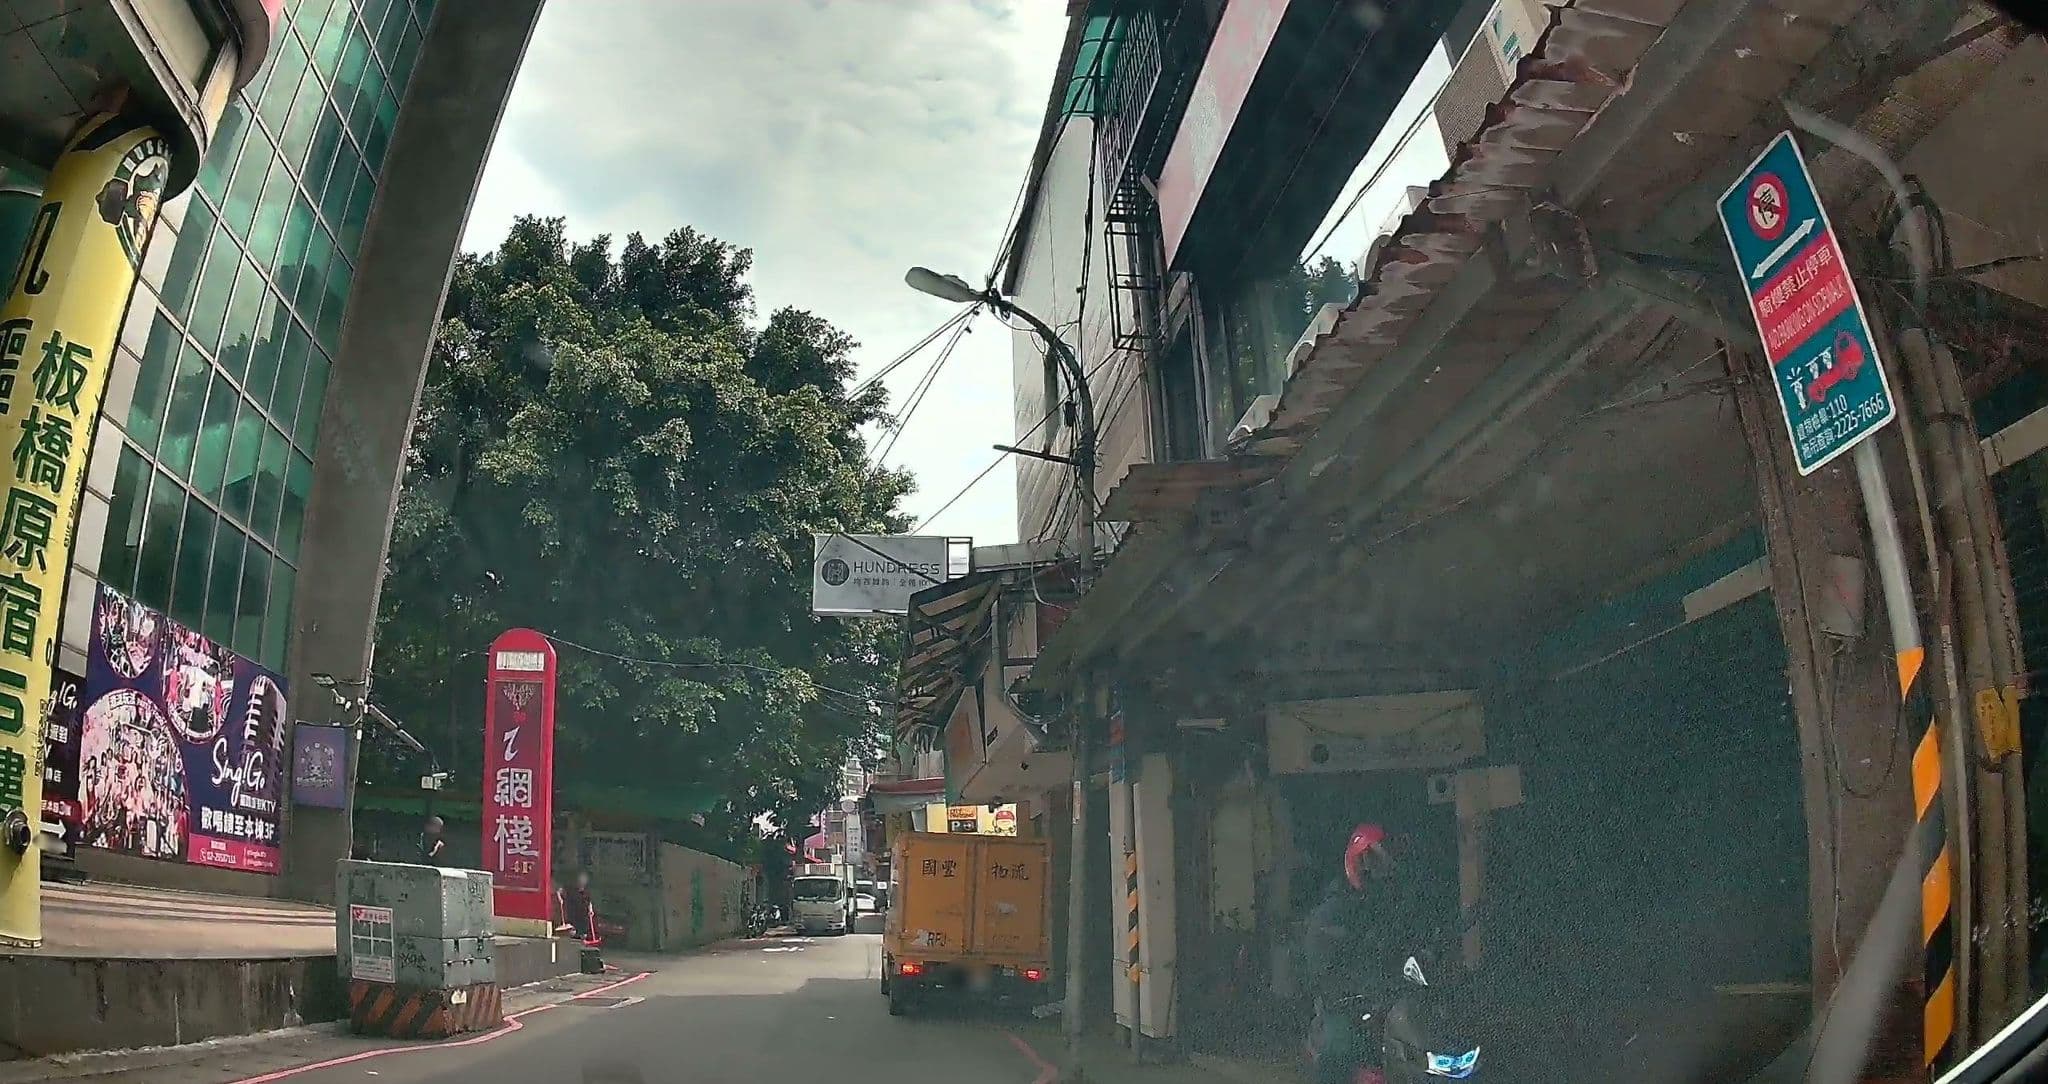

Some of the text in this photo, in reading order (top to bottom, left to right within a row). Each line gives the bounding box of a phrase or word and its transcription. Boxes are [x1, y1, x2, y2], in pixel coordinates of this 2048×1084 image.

[1758, 244, 1833, 318] 騎樓禁止停車
[853, 560, 940, 575] HUNDRESS
